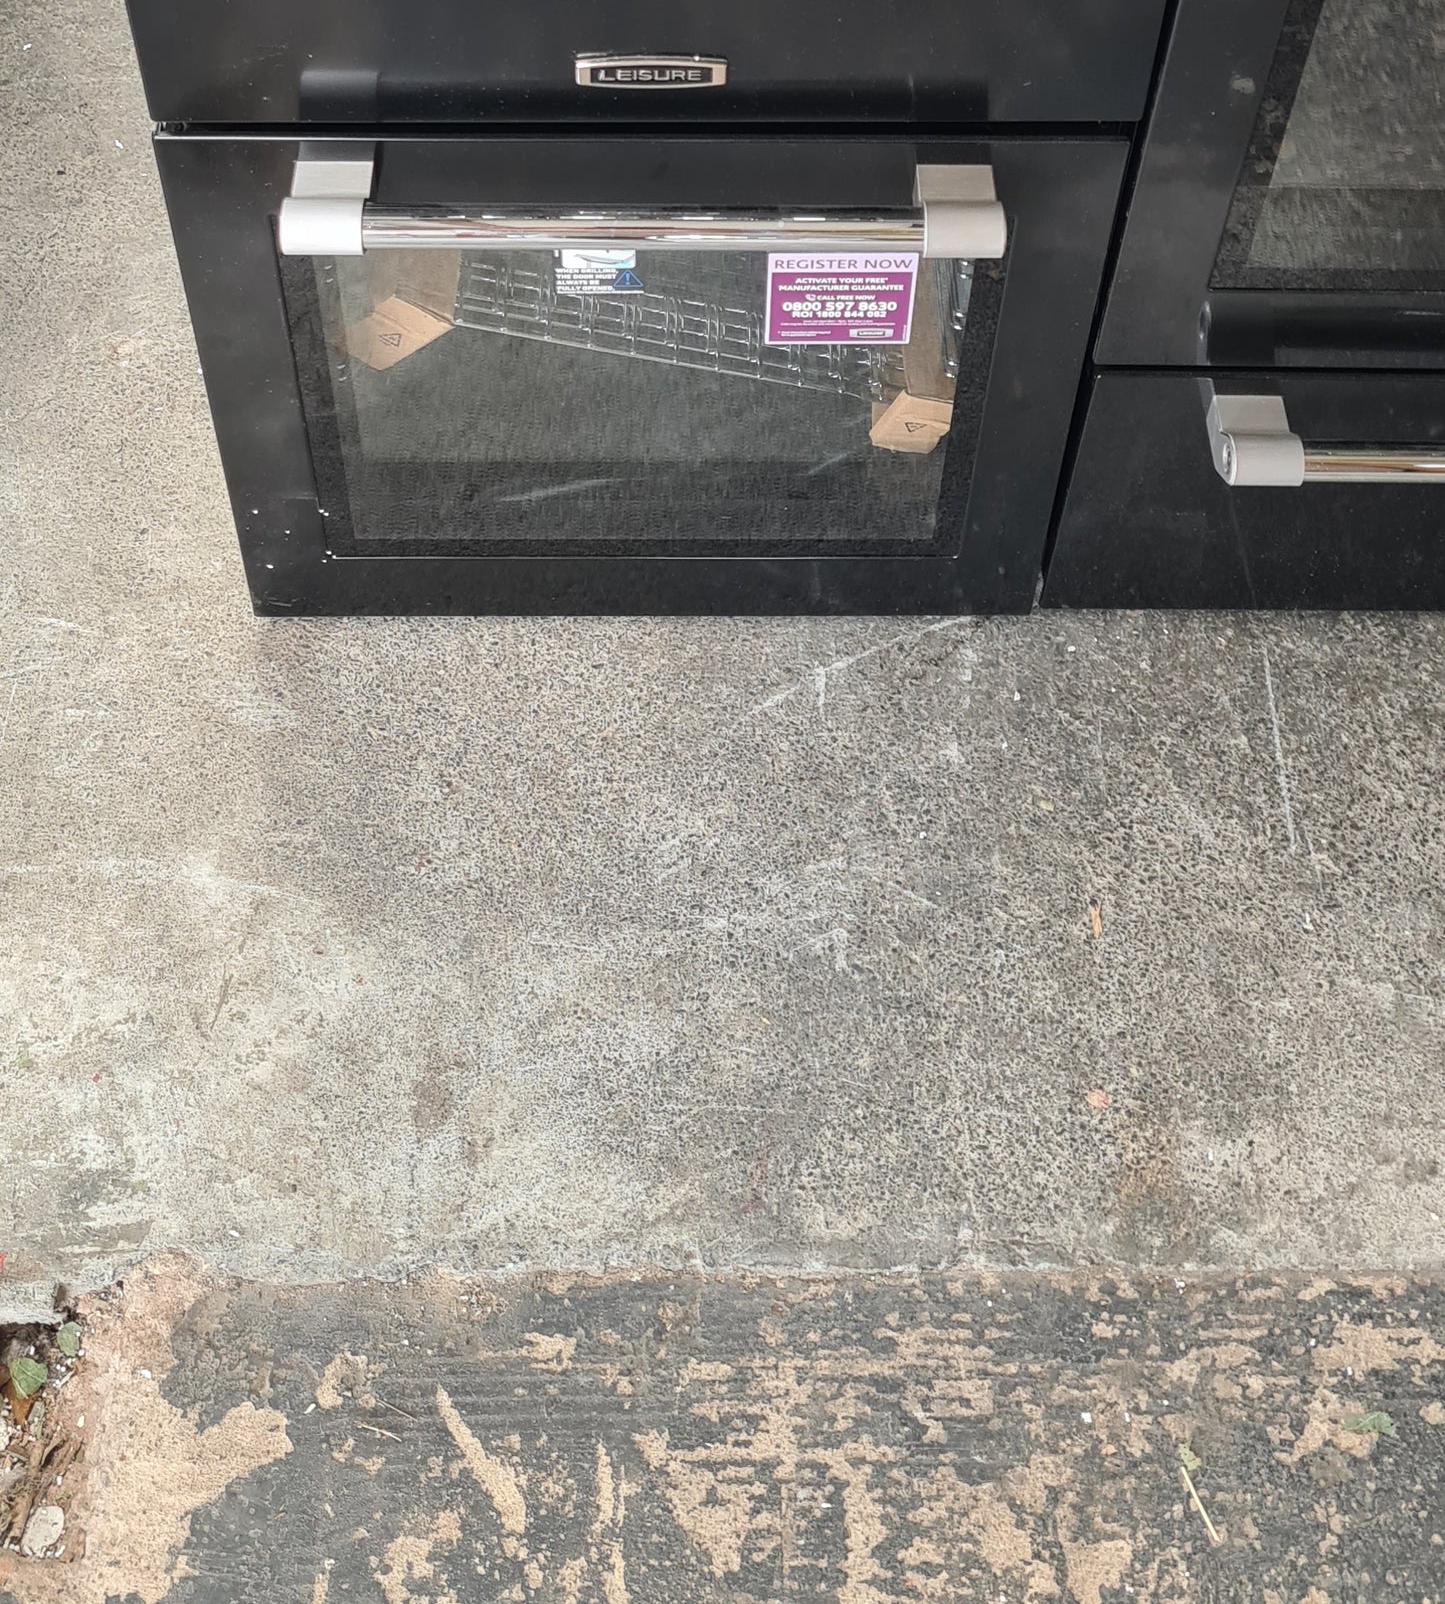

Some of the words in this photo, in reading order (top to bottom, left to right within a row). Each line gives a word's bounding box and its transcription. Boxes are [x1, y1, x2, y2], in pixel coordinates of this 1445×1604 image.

[598, 69, 702, 82] LEISURE
[774, 258, 858, 270] REGISTER
[863, 258, 913, 270] NOW
[778, 284, 850, 292] MANUFACTURER
[850, 284, 905, 292] GUARANTEE
[782, 301, 822, 312] 0800
[825, 301, 855, 312] 597
[857, 301, 898, 312] 8630
